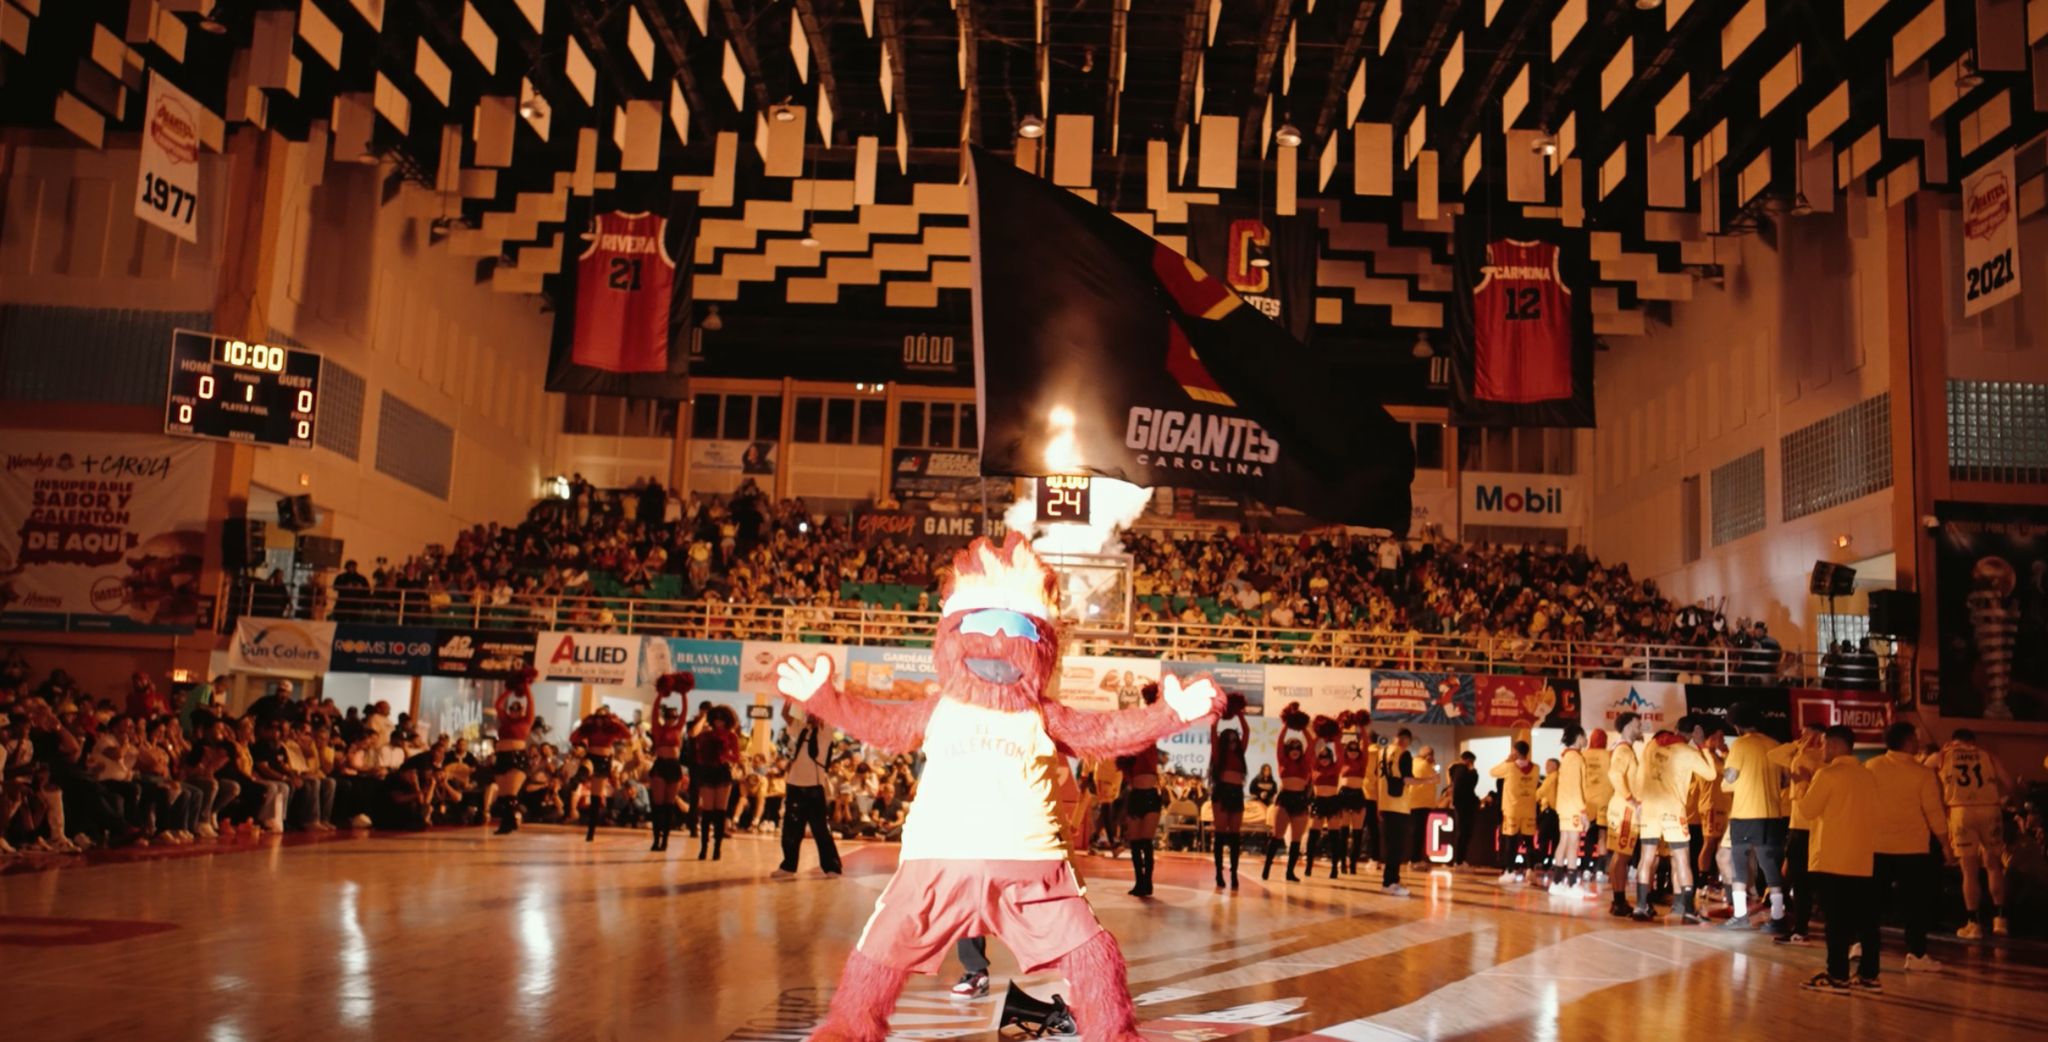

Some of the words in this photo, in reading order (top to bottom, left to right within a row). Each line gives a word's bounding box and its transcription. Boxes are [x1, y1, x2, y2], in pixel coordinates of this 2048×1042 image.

[142, 172, 196, 225] 1977
[601, 234, 656, 254] RIVERA
[1227, 219, 1271, 293] C
[608, 257, 642, 290] 21
[1494, 265, 1550, 281] CARMONA
[1966, 247, 2015, 301] 2021
[1504, 287, 1541, 320] 12
[181, 360, 213, 373] HOME
[224, 341, 284, 372] 10:00
[199, 376, 214, 399] 0
[278, 374, 313, 388] GUEST
[246, 385, 253, 402] 1
[297, 390, 312, 413] 0
[179, 405, 192, 423] 0
[297, 421, 310, 438] 0
[1125, 406, 1280, 465] GIGANTES
[100, 454, 171, 480] CAROLA
[1136, 453, 1263, 478] CAROLINA
[34, 480, 134, 492] INSUPERABLE
[32, 491, 111, 509] SABOR
[117, 493, 133, 509] Y
[1047, 488, 1081, 516] 24
[1475, 485, 1561, 514] Mobil
[924, 516, 974, 536] GAME
[28, 531, 60, 550] DE
[241, 642, 269, 658] Sun
[334, 639, 386, 655] ROOMS
[389, 640, 405, 656] TO
[408, 642, 432, 657] GO
[550, 635, 627, 665] ALLIED
[677, 652, 739, 666] BRAVADA
[691, 665, 723, 675] VODKA
[1691, 707, 1728, 716] PLAZA
[1842, 709, 1884, 727] MEDIA
[1170, 752, 1204, 764] uerto
[1952, 763, 1984, 789] 31
[1426, 812, 1454, 863] C
